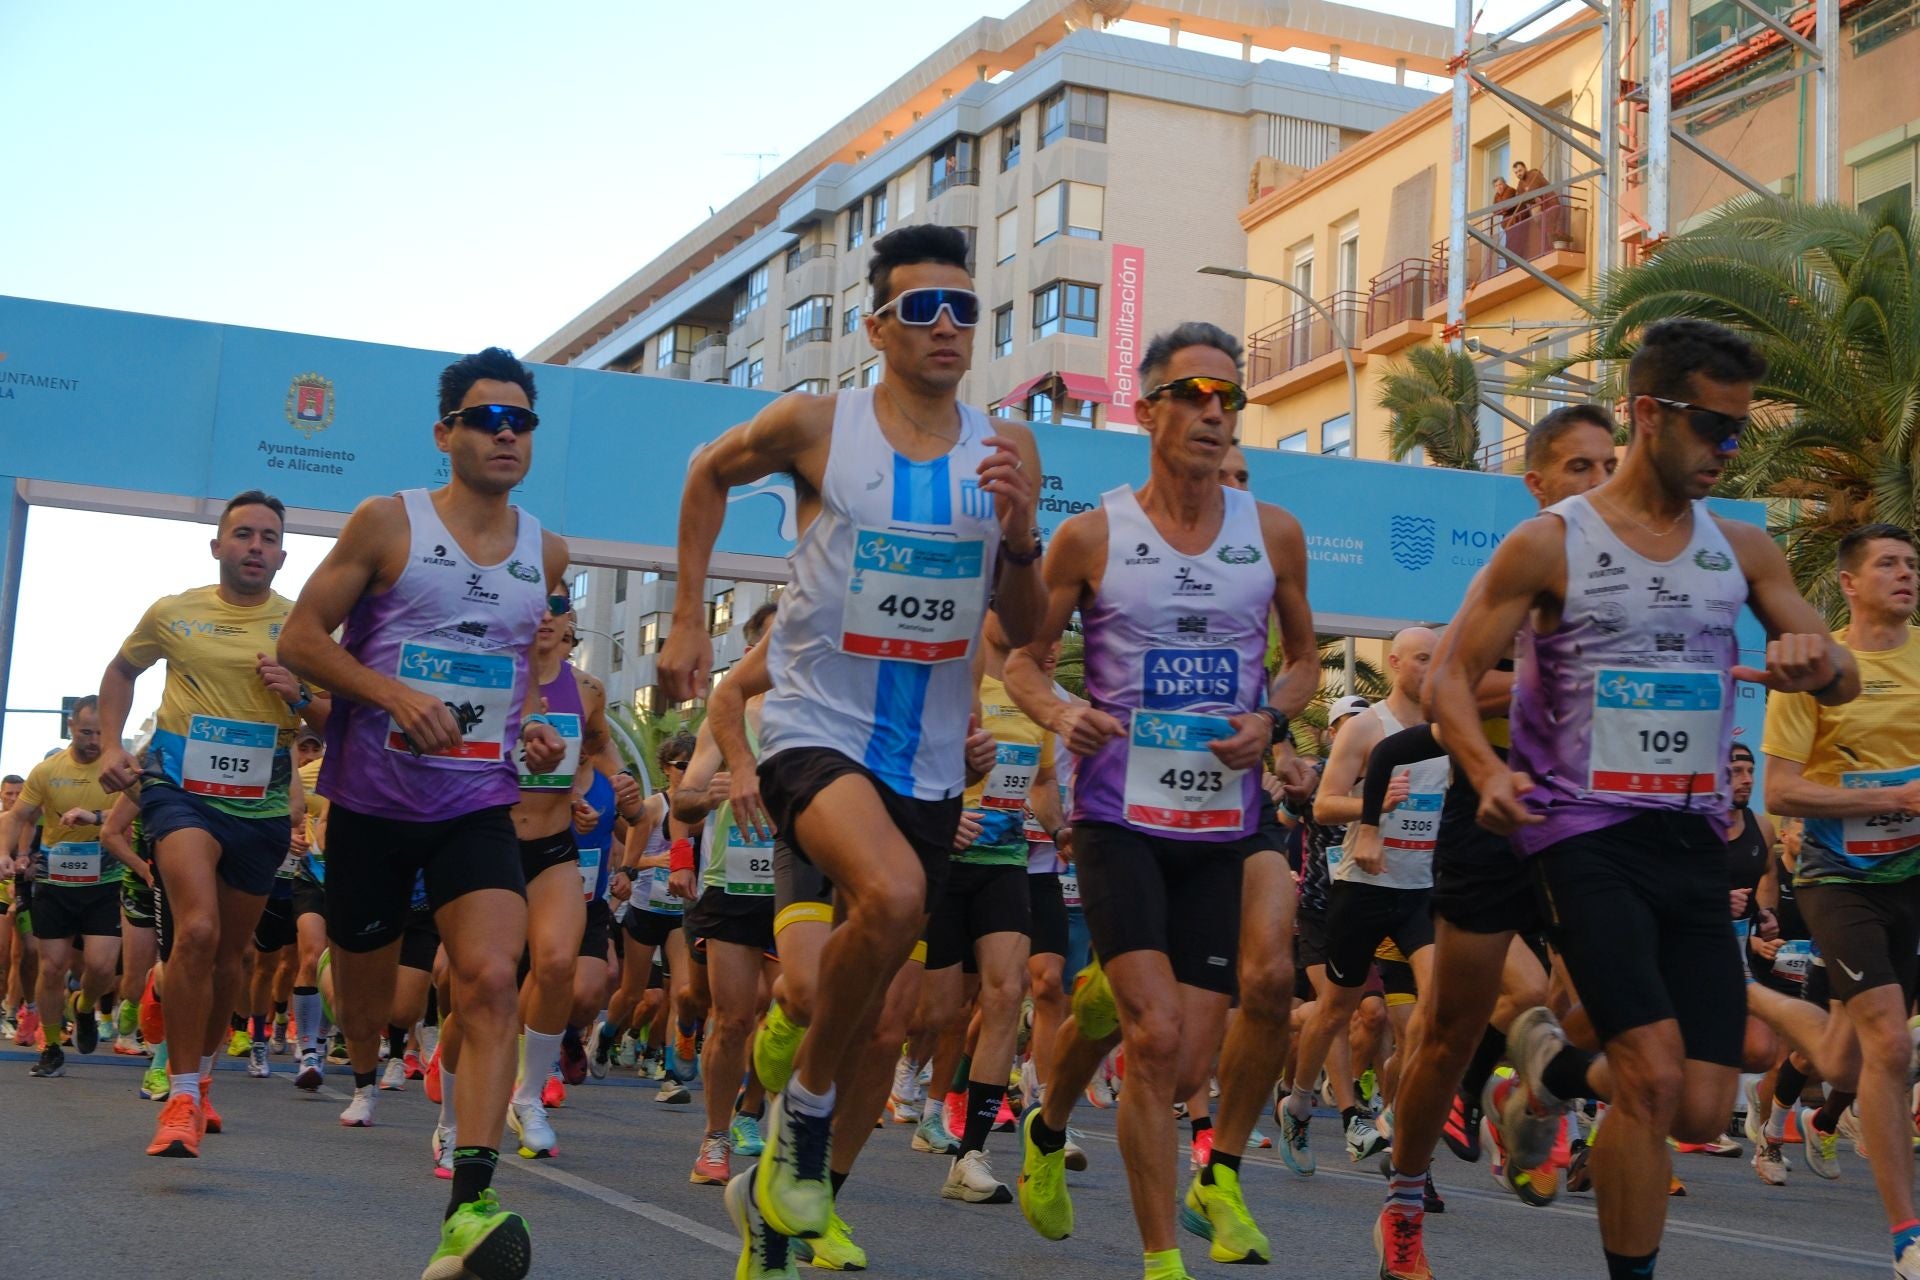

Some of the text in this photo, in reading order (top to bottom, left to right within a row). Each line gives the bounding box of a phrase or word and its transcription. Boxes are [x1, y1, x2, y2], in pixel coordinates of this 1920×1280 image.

[1112, 257, 1137, 408] Rehabilitación
[257, 440, 356, 461] Ayuntamiento
[267, 456, 344, 475] de Alicante
[423, 556, 457, 568] VIATOR
[892, 546, 915, 564] VI
[1306, 550, 1364, 565] ALICANTE
[878, 594, 956, 621] 4038
[1150, 656, 1234, 678] AQUA
[1154, 679, 1231, 696] DEUS
[1638, 730, 1689, 753] 109
[209, 755, 251, 773] 1613
[1159, 768, 1223, 792] 4923
[1400, 819, 1433, 831] 3306
[60, 861, 89, 870] 4892
[750, 859, 774, 872] 82
